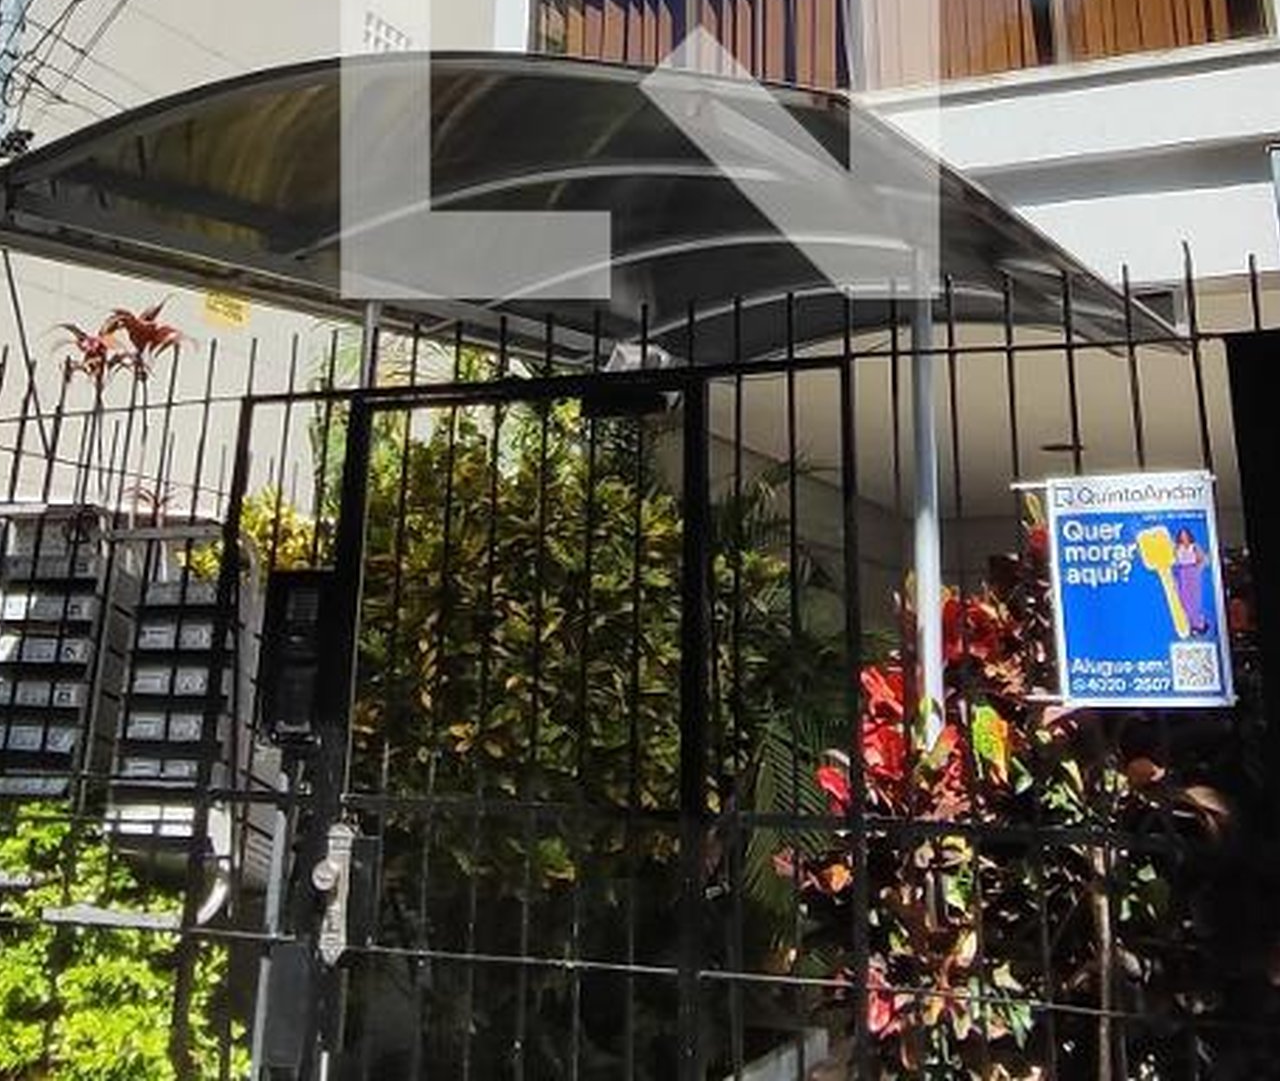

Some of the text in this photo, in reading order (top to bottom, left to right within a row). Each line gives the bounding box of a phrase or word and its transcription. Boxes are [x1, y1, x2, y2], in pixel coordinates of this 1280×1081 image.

[1078, 484, 1205, 505] QuintoAndar
[1062, 520, 1124, 542] Quer
[1064, 542, 1138, 563] morar
[1066, 561, 1132, 588] aqui?
